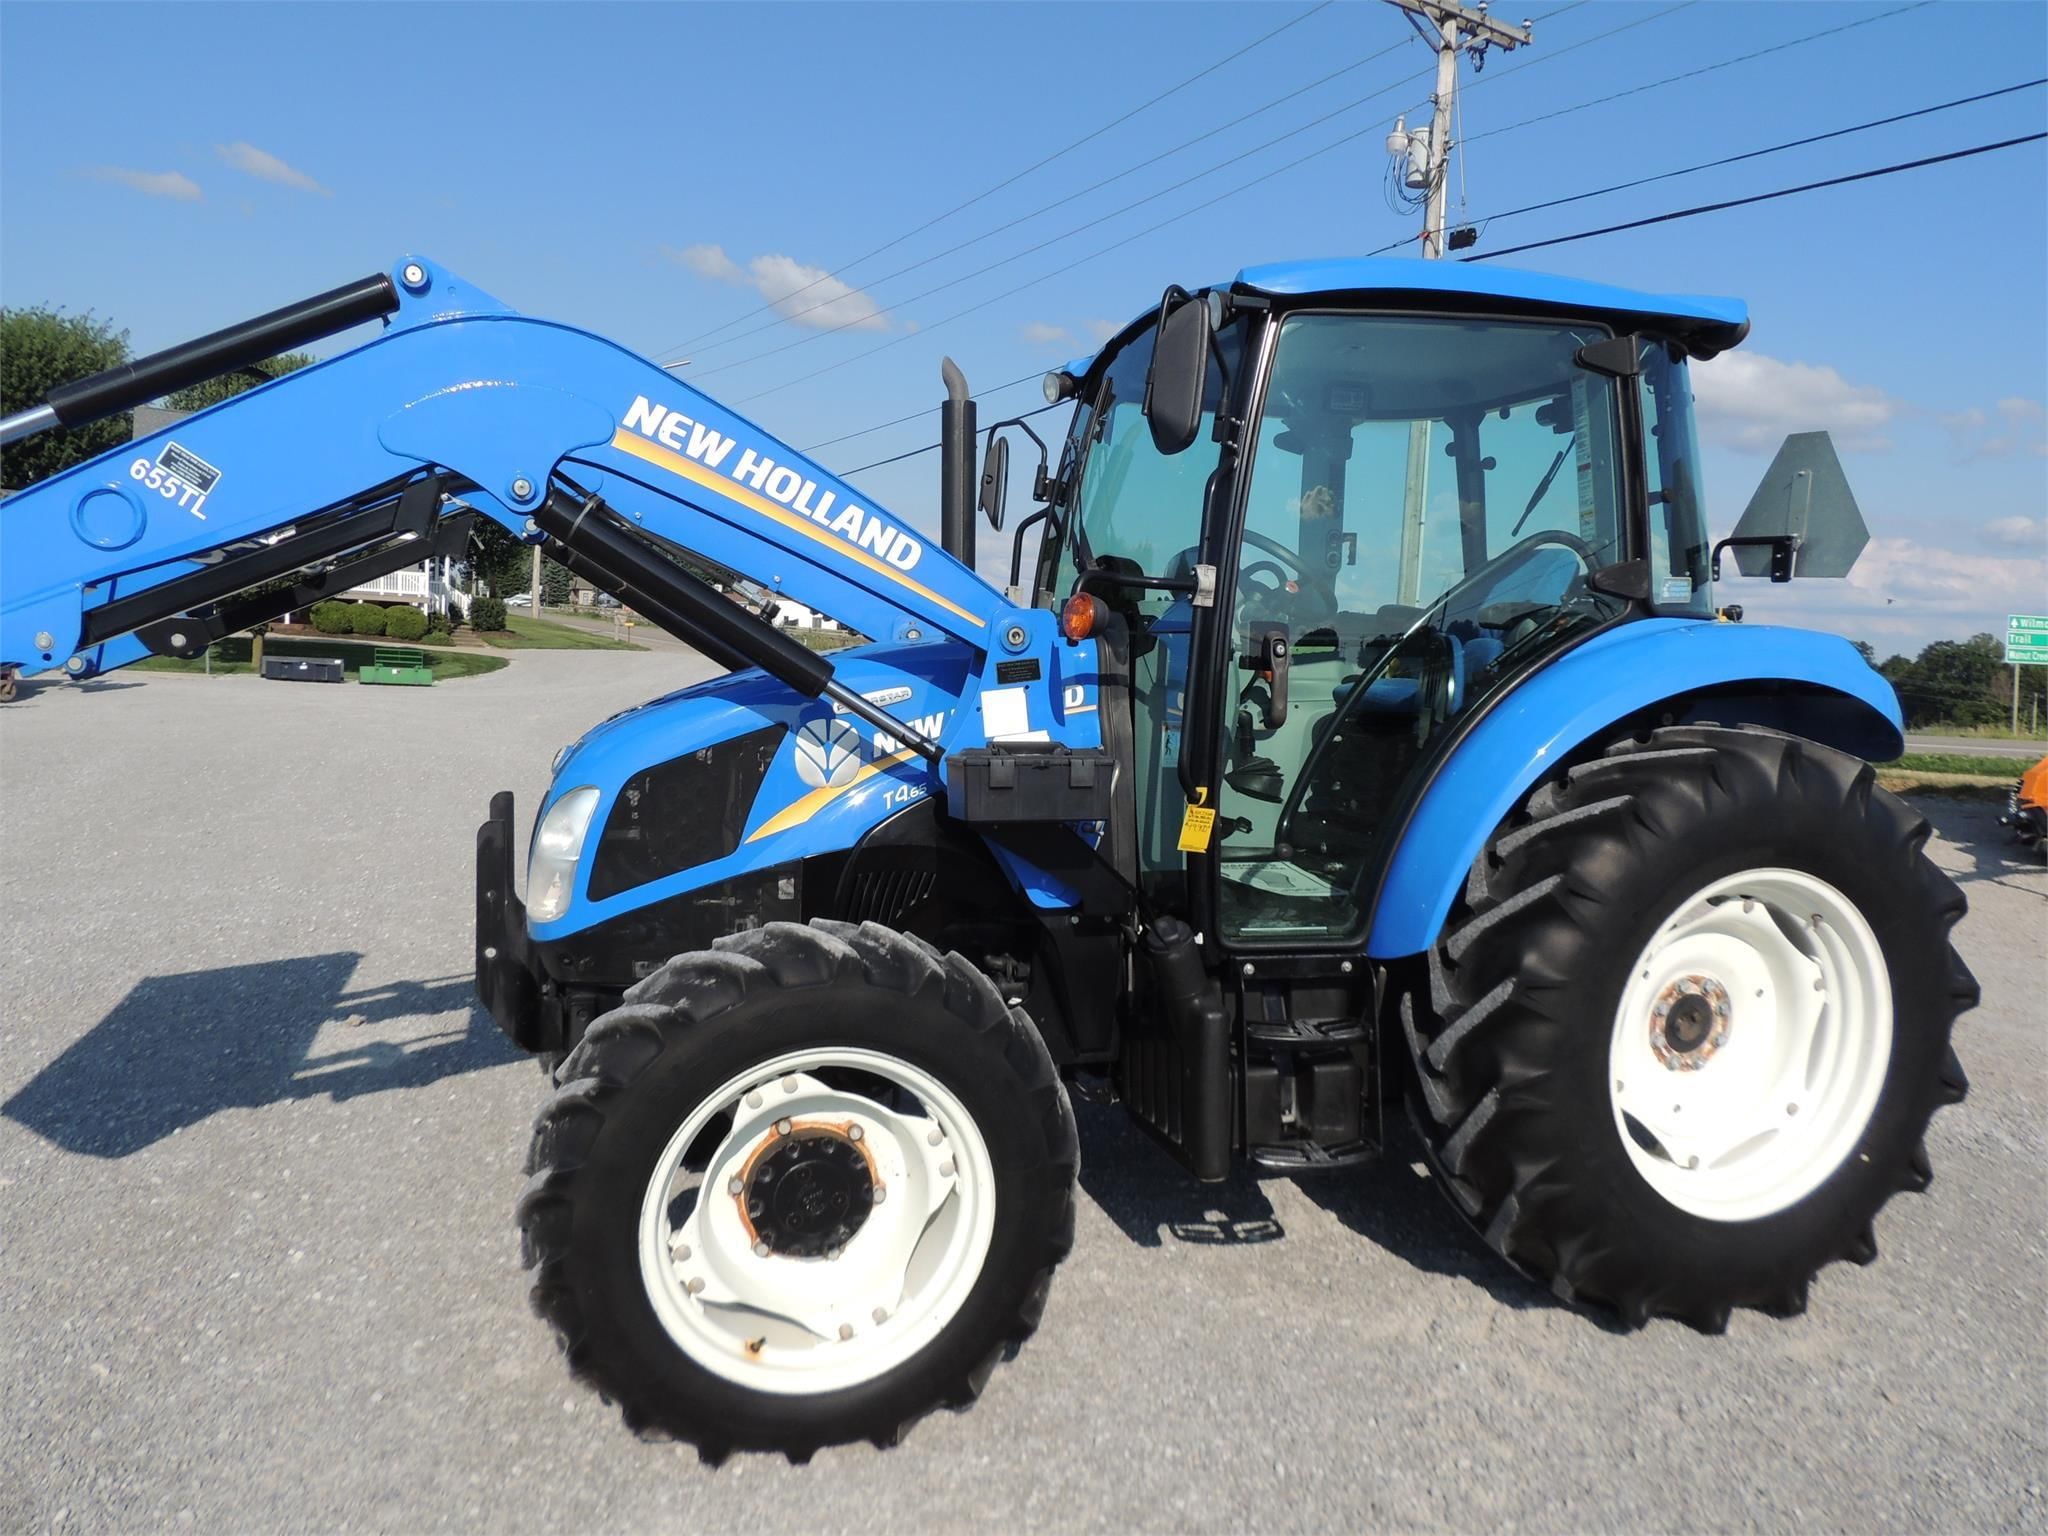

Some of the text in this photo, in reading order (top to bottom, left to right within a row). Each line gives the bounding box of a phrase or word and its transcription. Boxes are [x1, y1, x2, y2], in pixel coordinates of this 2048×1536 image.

[130, 458, 207, 521] 655TL
[622, 395, 922, 571] NEW HOLLAND
[2010, 633, 2032, 644] Trail
[883, 782, 928, 811] T4.65
